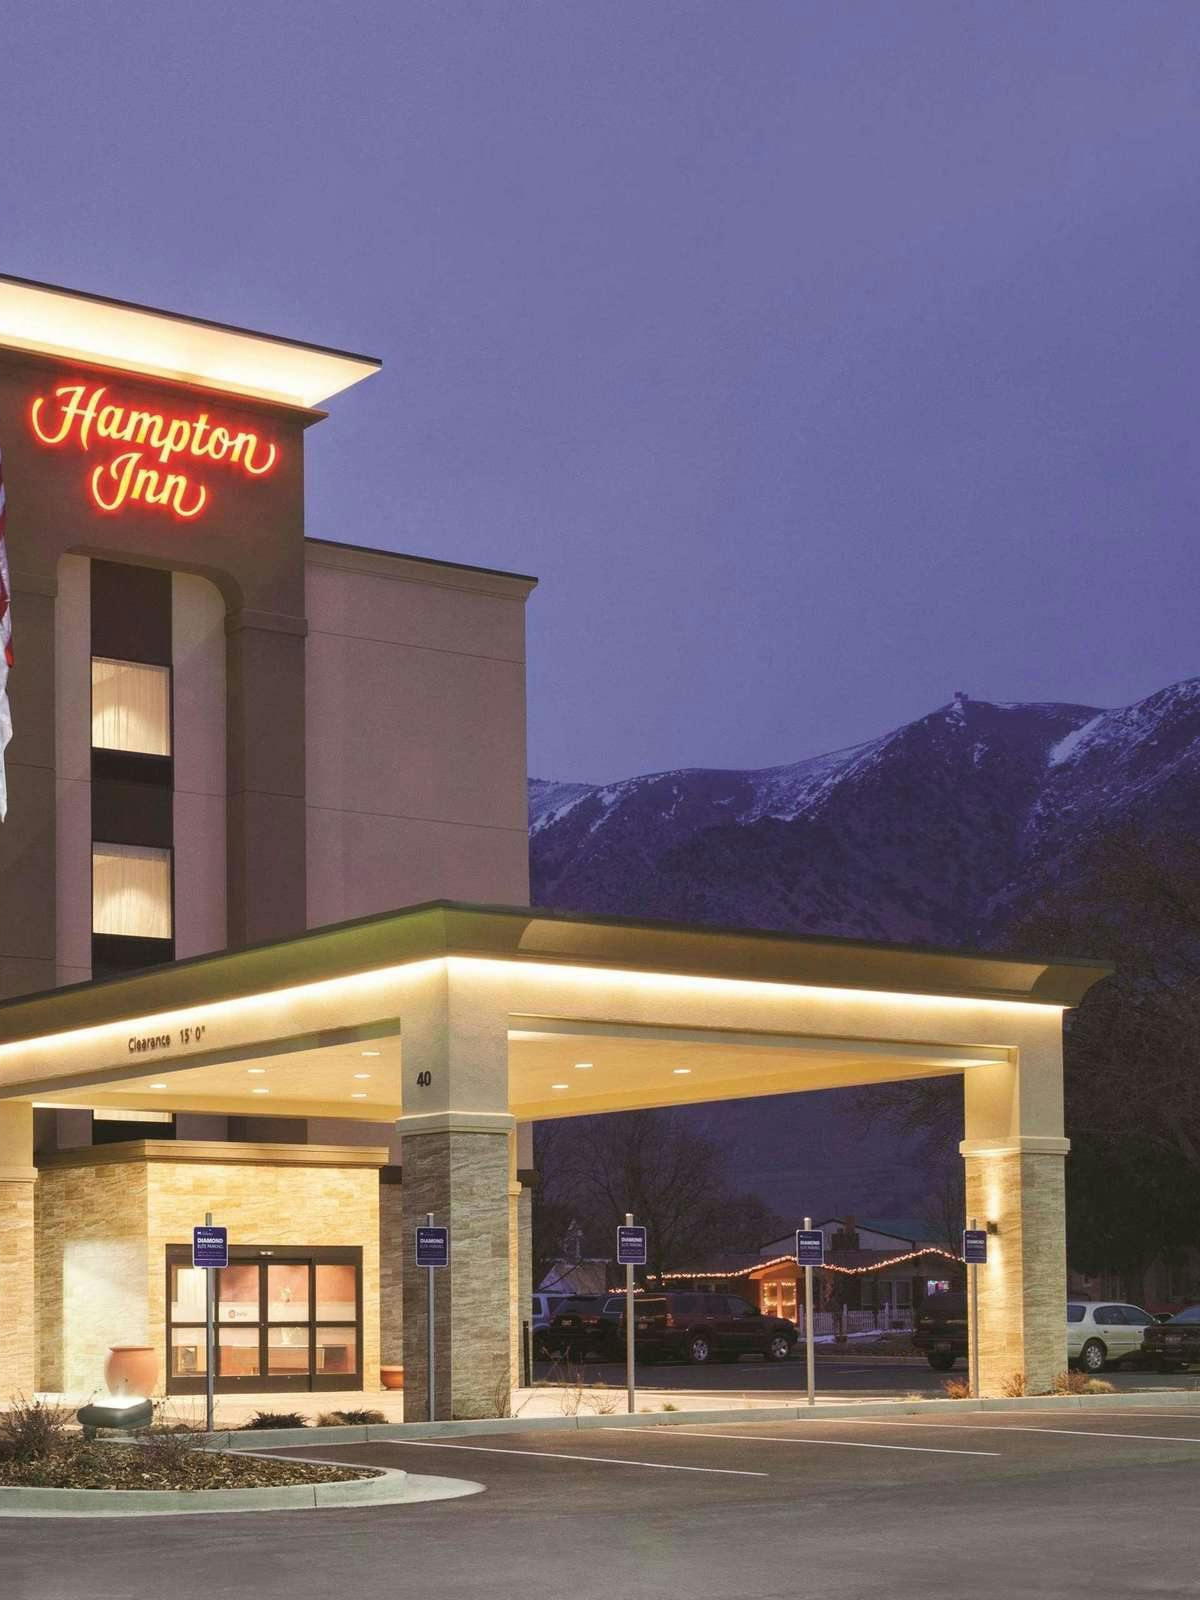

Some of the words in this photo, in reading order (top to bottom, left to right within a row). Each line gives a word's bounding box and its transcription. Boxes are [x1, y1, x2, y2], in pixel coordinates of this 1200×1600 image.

[31, 385, 276, 474] Hampton
[91, 452, 207, 517] Inn
[128, 1034, 171, 1054] Clearance
[416, 1070, 432, 1087] 40
